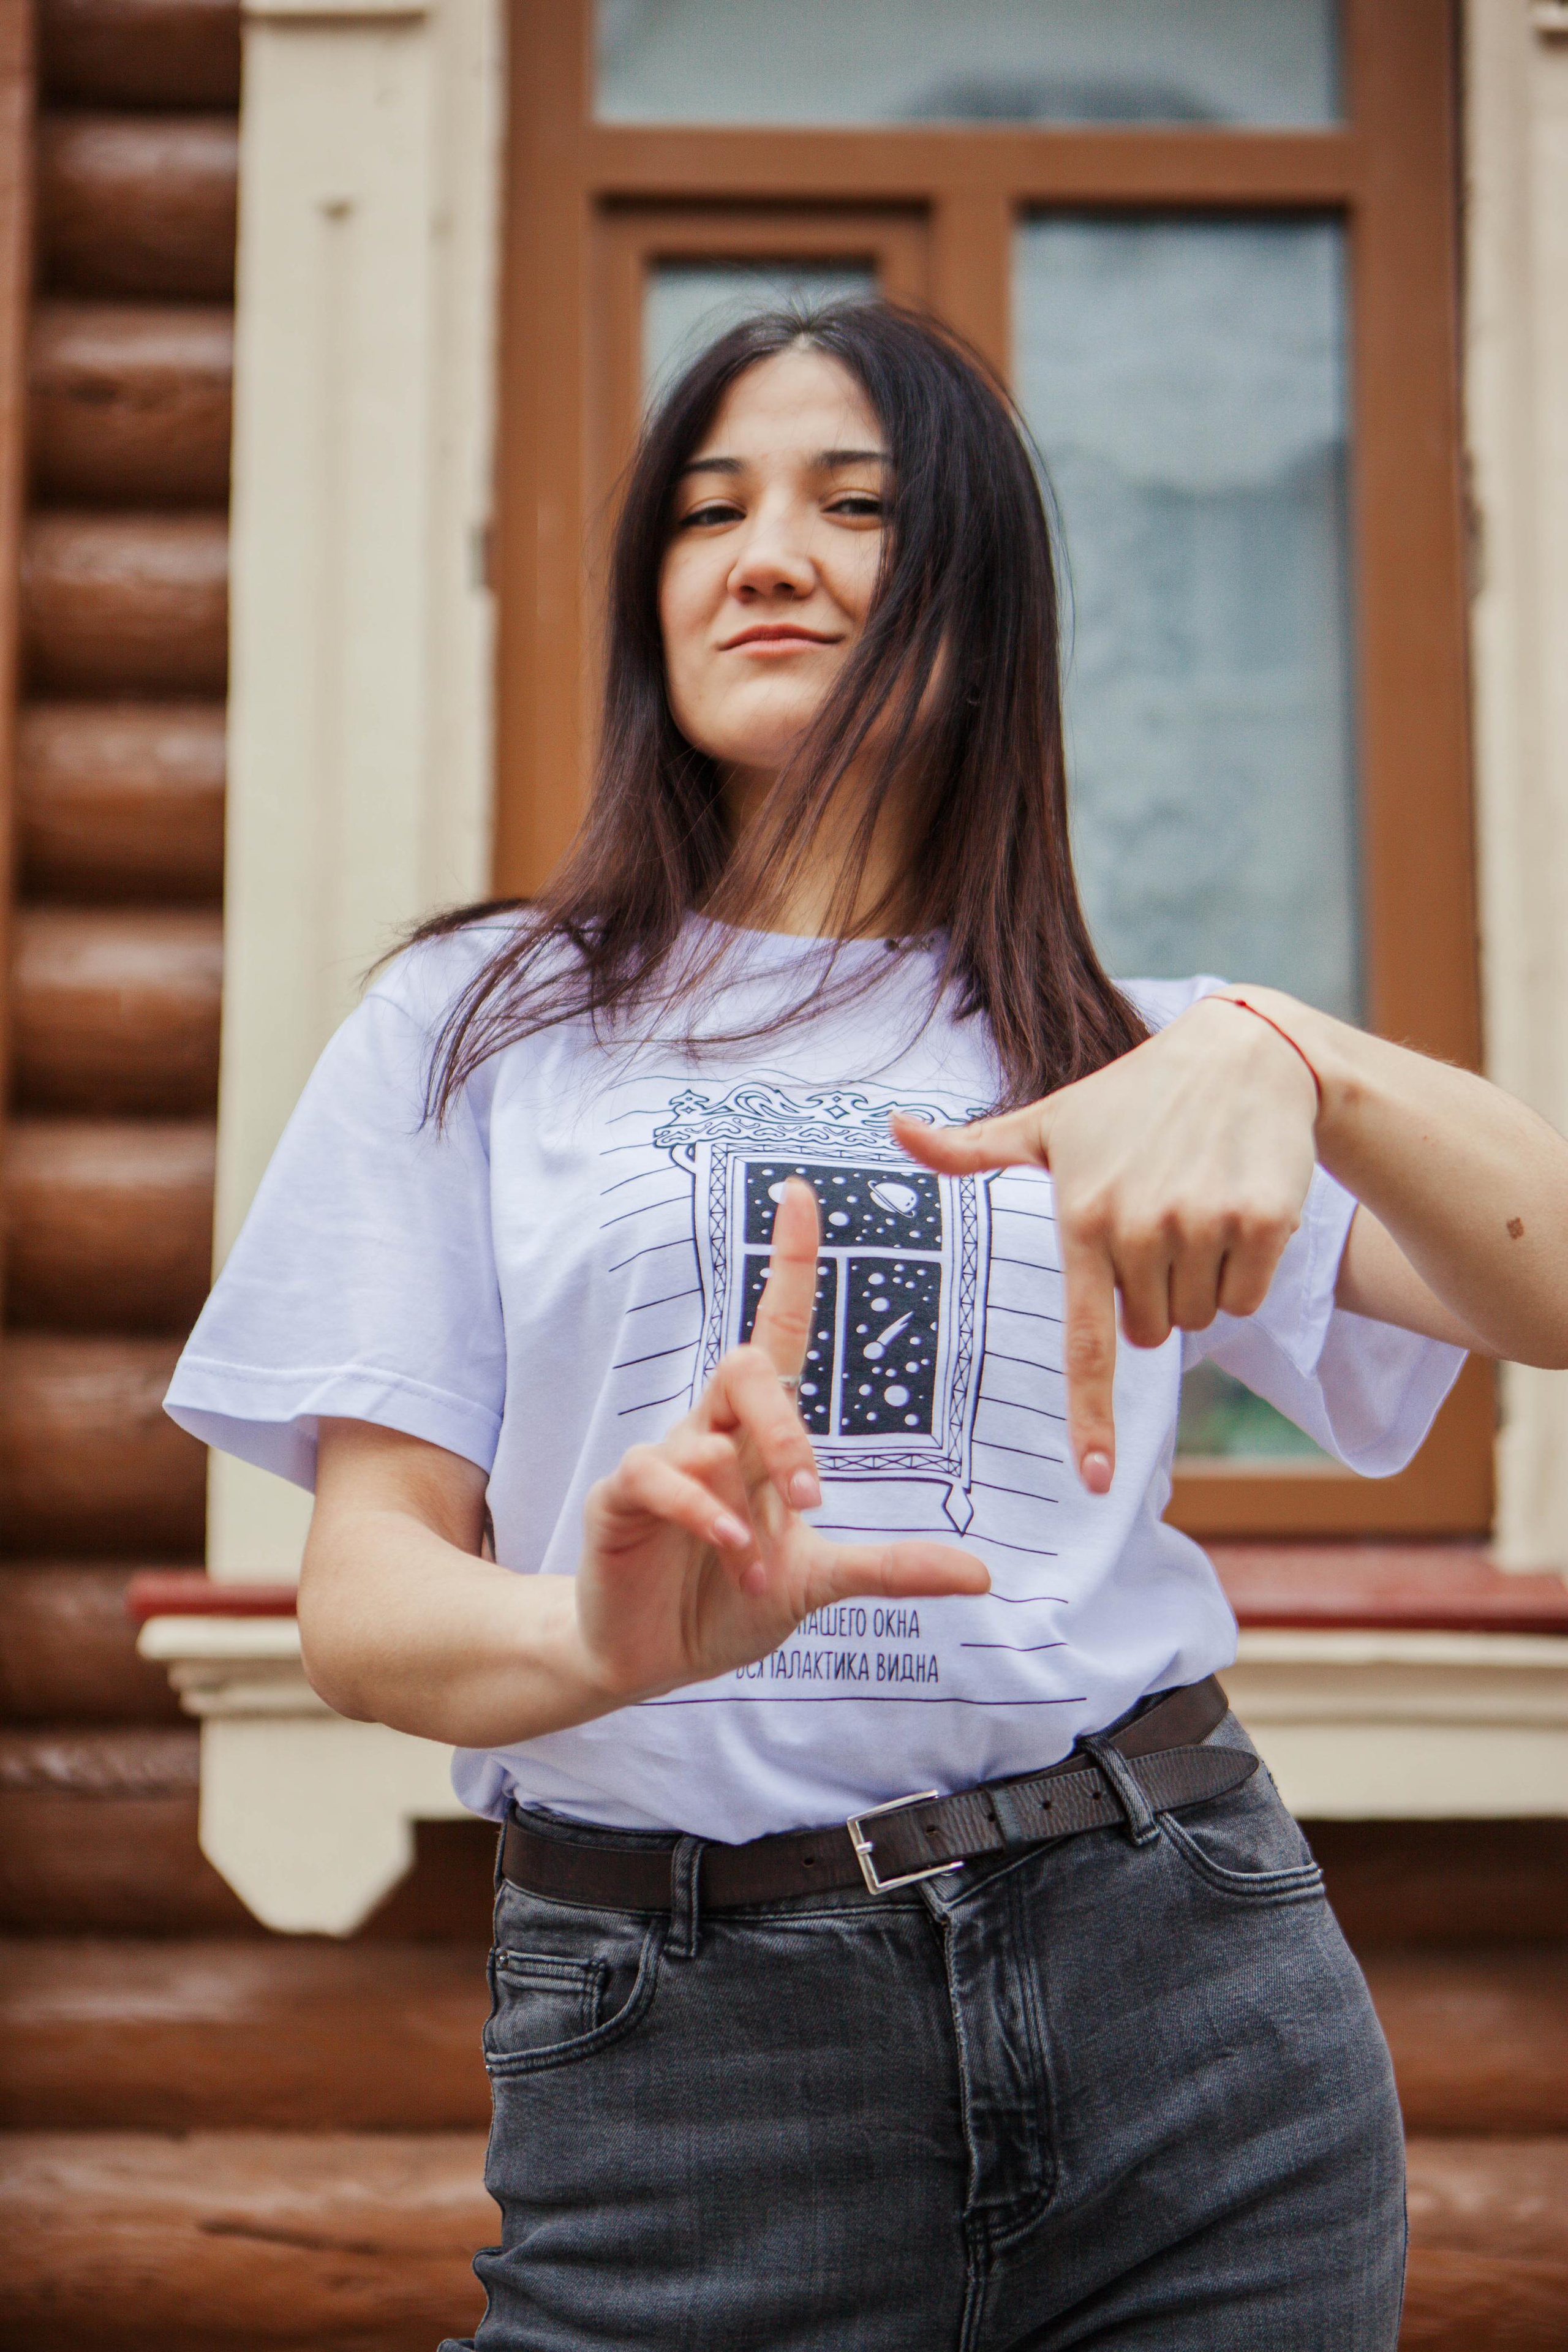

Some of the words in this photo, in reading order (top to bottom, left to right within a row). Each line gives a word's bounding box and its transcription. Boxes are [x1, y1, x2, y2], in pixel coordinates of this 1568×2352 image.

[873, 1608, 919, 1638] ОКНА
[771, 1650, 869, 1680] ГАЛАКТИКА
[876, 1653, 938, 1683] ВИДНА
